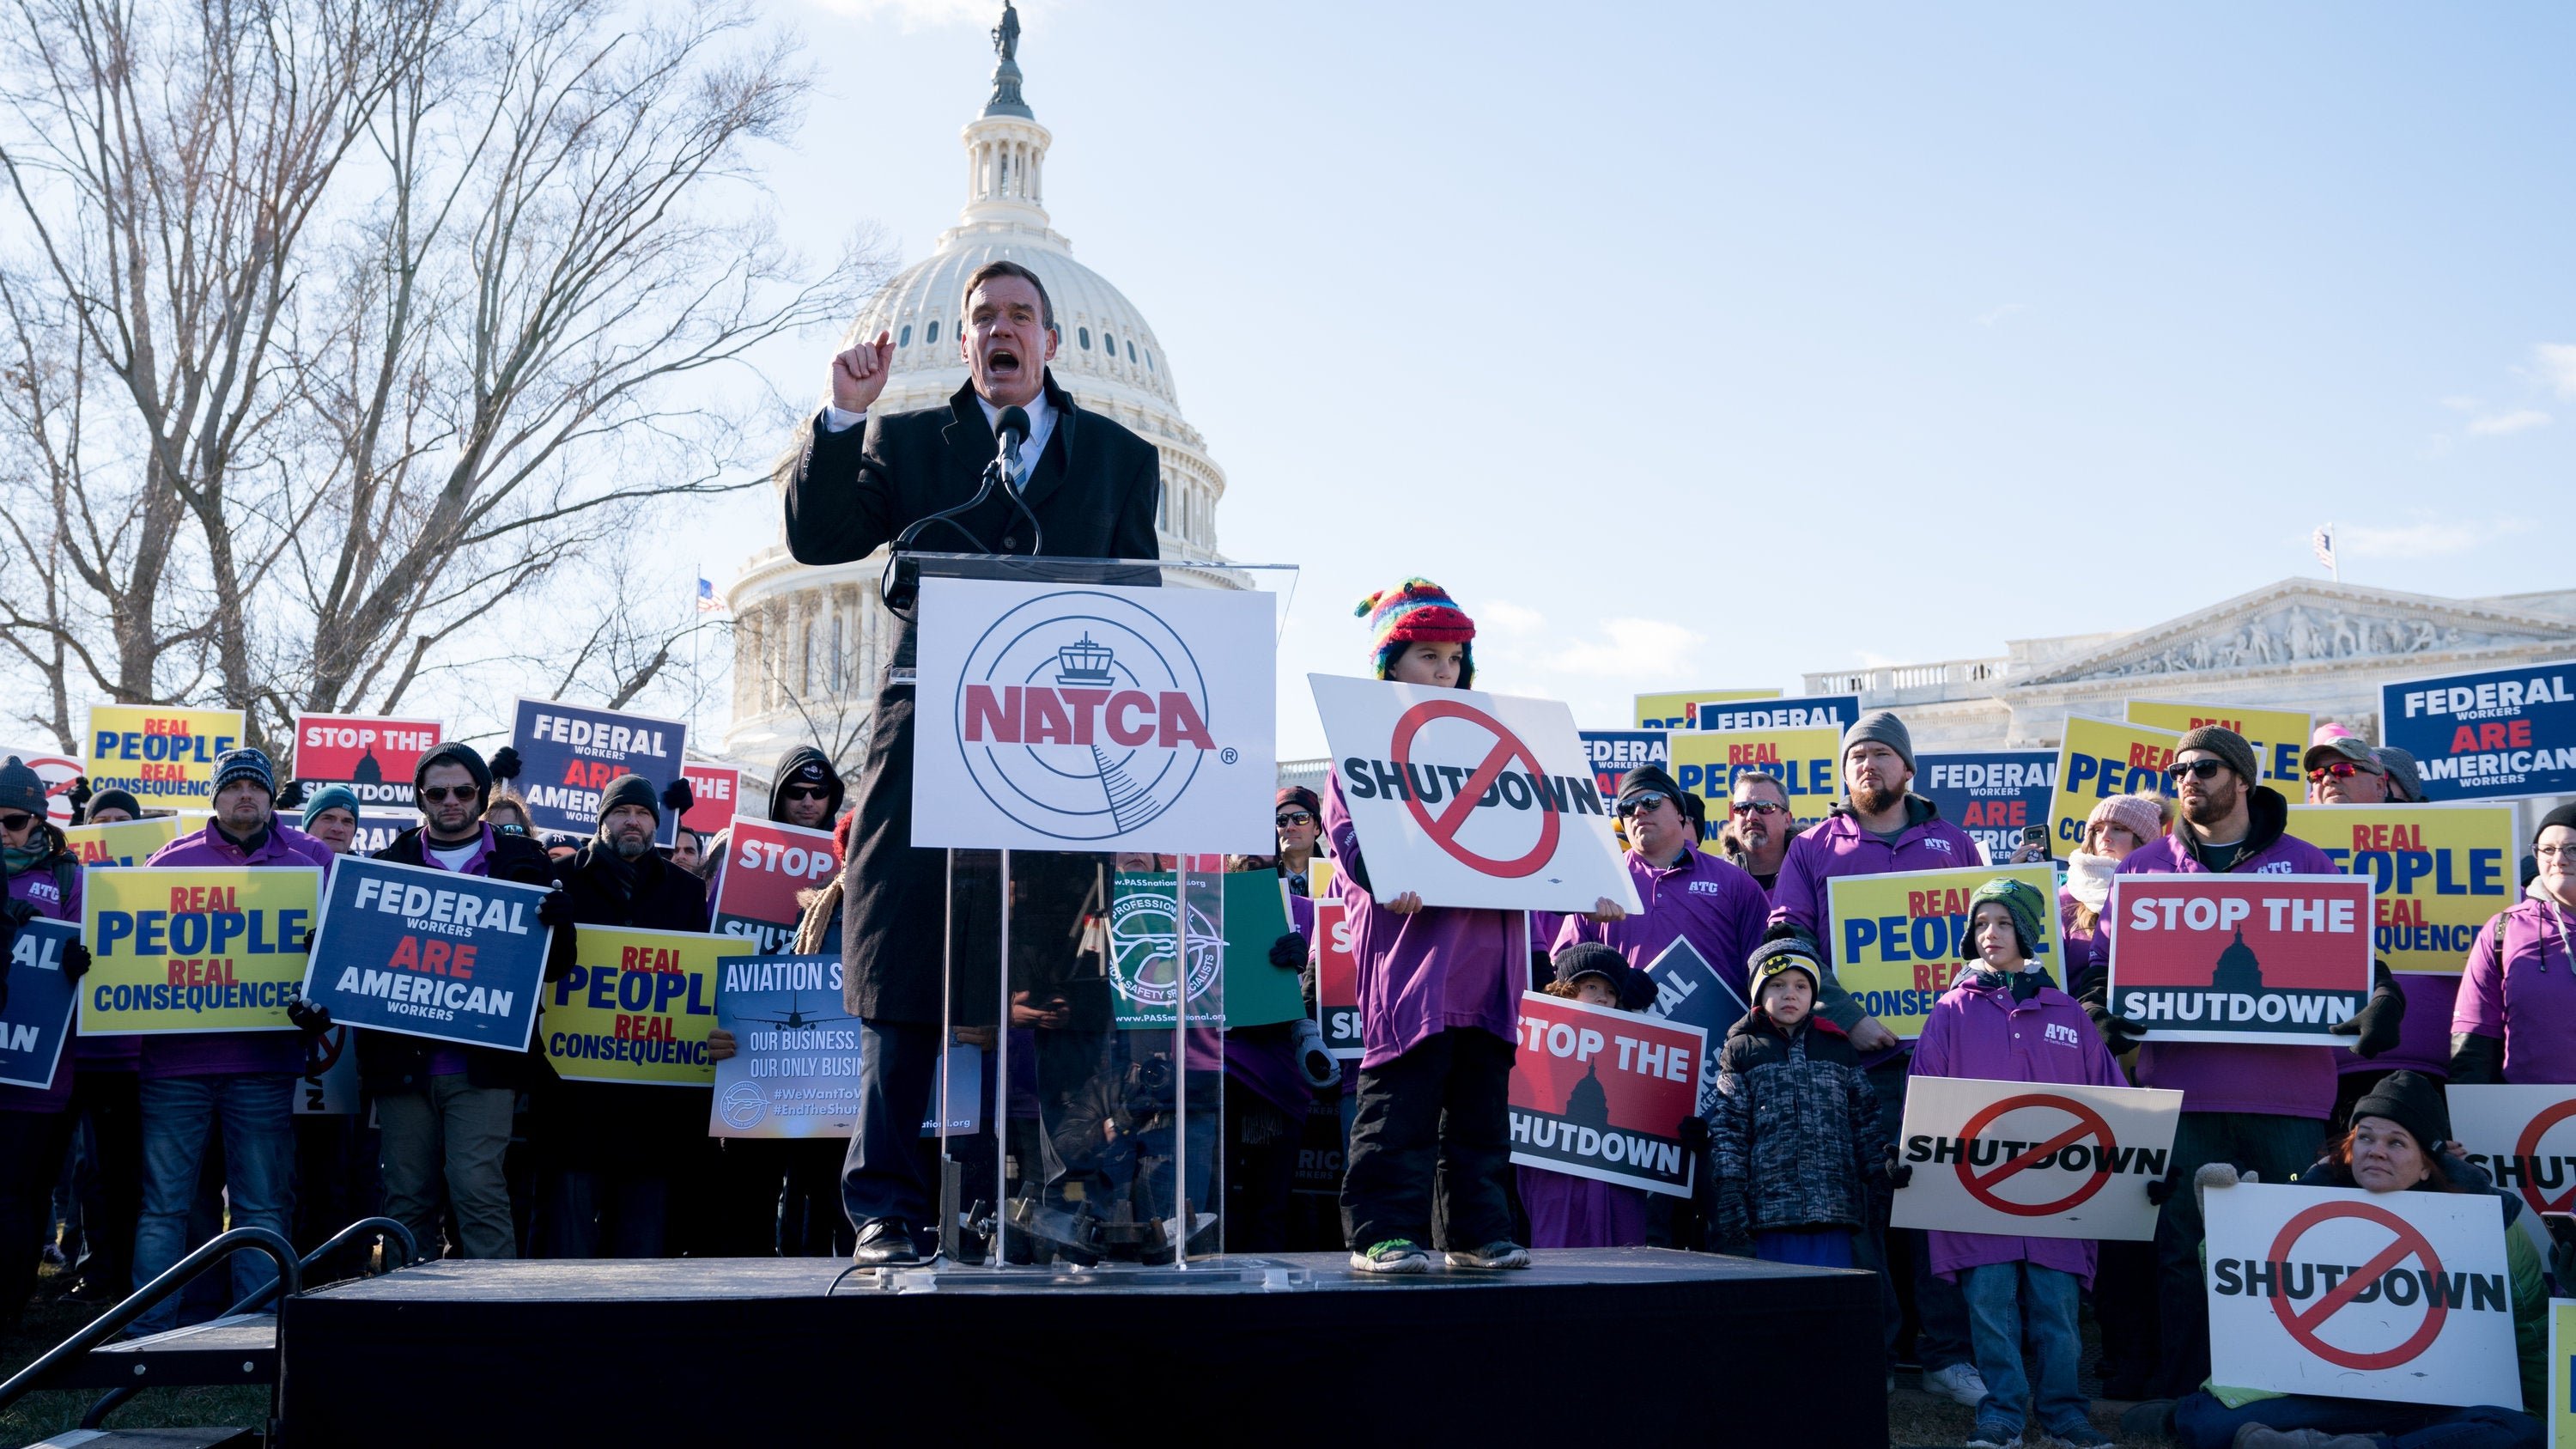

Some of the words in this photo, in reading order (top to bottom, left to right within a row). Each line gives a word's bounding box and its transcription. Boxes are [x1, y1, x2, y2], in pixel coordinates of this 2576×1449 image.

[2405, 676, 2575, 718] FEDERAL
[144, 718, 191, 737] REAL
[964, 685, 1217, 750] NATCA
[1718, 707, 1843, 729] FEDERAL
[2456, 706, 2521, 721] WORKERS
[306, 727, 377, 749] STOP
[383, 730, 434, 752] THE
[533, 714, 667, 758] FEDERAL
[2450, 719, 2532, 753] ARE
[574, 745, 626, 760] WORKERS
[1581, 740, 1668, 762] EDERA
[1728, 743, 1781, 765] REAL
[2129, 742, 2174, 773] REA
[2415, 746, 2576, 781] AMERICAN
[92, 776, 210, 797] CONSEQUENC
[140, 764, 187, 782] REAL
[1344, 758, 1604, 815] SHUTDOWN
[2459, 773, 2525, 788] WORKERS
[526, 784, 600, 813] AMER
[1970, 788, 2020, 796] WORKERS
[566, 811, 598, 823] WORK
[1961, 801, 2026, 827] ARE
[2353, 824, 2428, 852] REAL
[738, 839, 834, 880] STOP
[28, 881, 59, 900] ATC
[170, 886, 241, 914] REAL
[1688, 881, 1717, 892] ATC
[354, 877, 528, 935] FEDERAL
[2129, 897, 2251, 931] STOP
[2262, 898, 2354, 933] THE
[2375, 898, 2429, 928] EAL
[96, 909, 308, 956] PEOPLE
[406, 917, 472, 937] WORKERS
[388, 935, 478, 979] ARE
[621, 946, 683, 975] REAL
[167, 959, 240, 987] REAL
[725, 962, 823, 992] AVIATION
[335, 965, 513, 1017] AMERICAN
[555, 965, 719, 1015] PEOPL
[1125, 980, 1164, 999] SAFETY
[387, 1001, 454, 1021] WORKERS
[2123, 991, 2355, 1025] SHUTDOWN
[614, 1014, 677, 1043] REAL
[750, 1032, 778, 1051] OUR
[781, 1031, 859, 1050] BUSINESS.
[2044, 1023, 2078, 1044] ATC
[550, 1032, 717, 1066] CONSEQUENC
[1614, 1035, 1690, 1083] THE
[750, 1058, 778, 1078] OUR
[781, 1057, 818, 1077] ONLY
[822, 1056, 862, 1077] BUSIN
[774, 1088, 861, 1100] #WeWantTo
[773, 1103, 860, 1116] #EndTheShut
[1510, 1111, 1680, 1174] HUTDOWN
[1905, 1135, 2167, 1175] SHUTDOWN
[2214, 1257, 2507, 1312] SHUTDOWN
